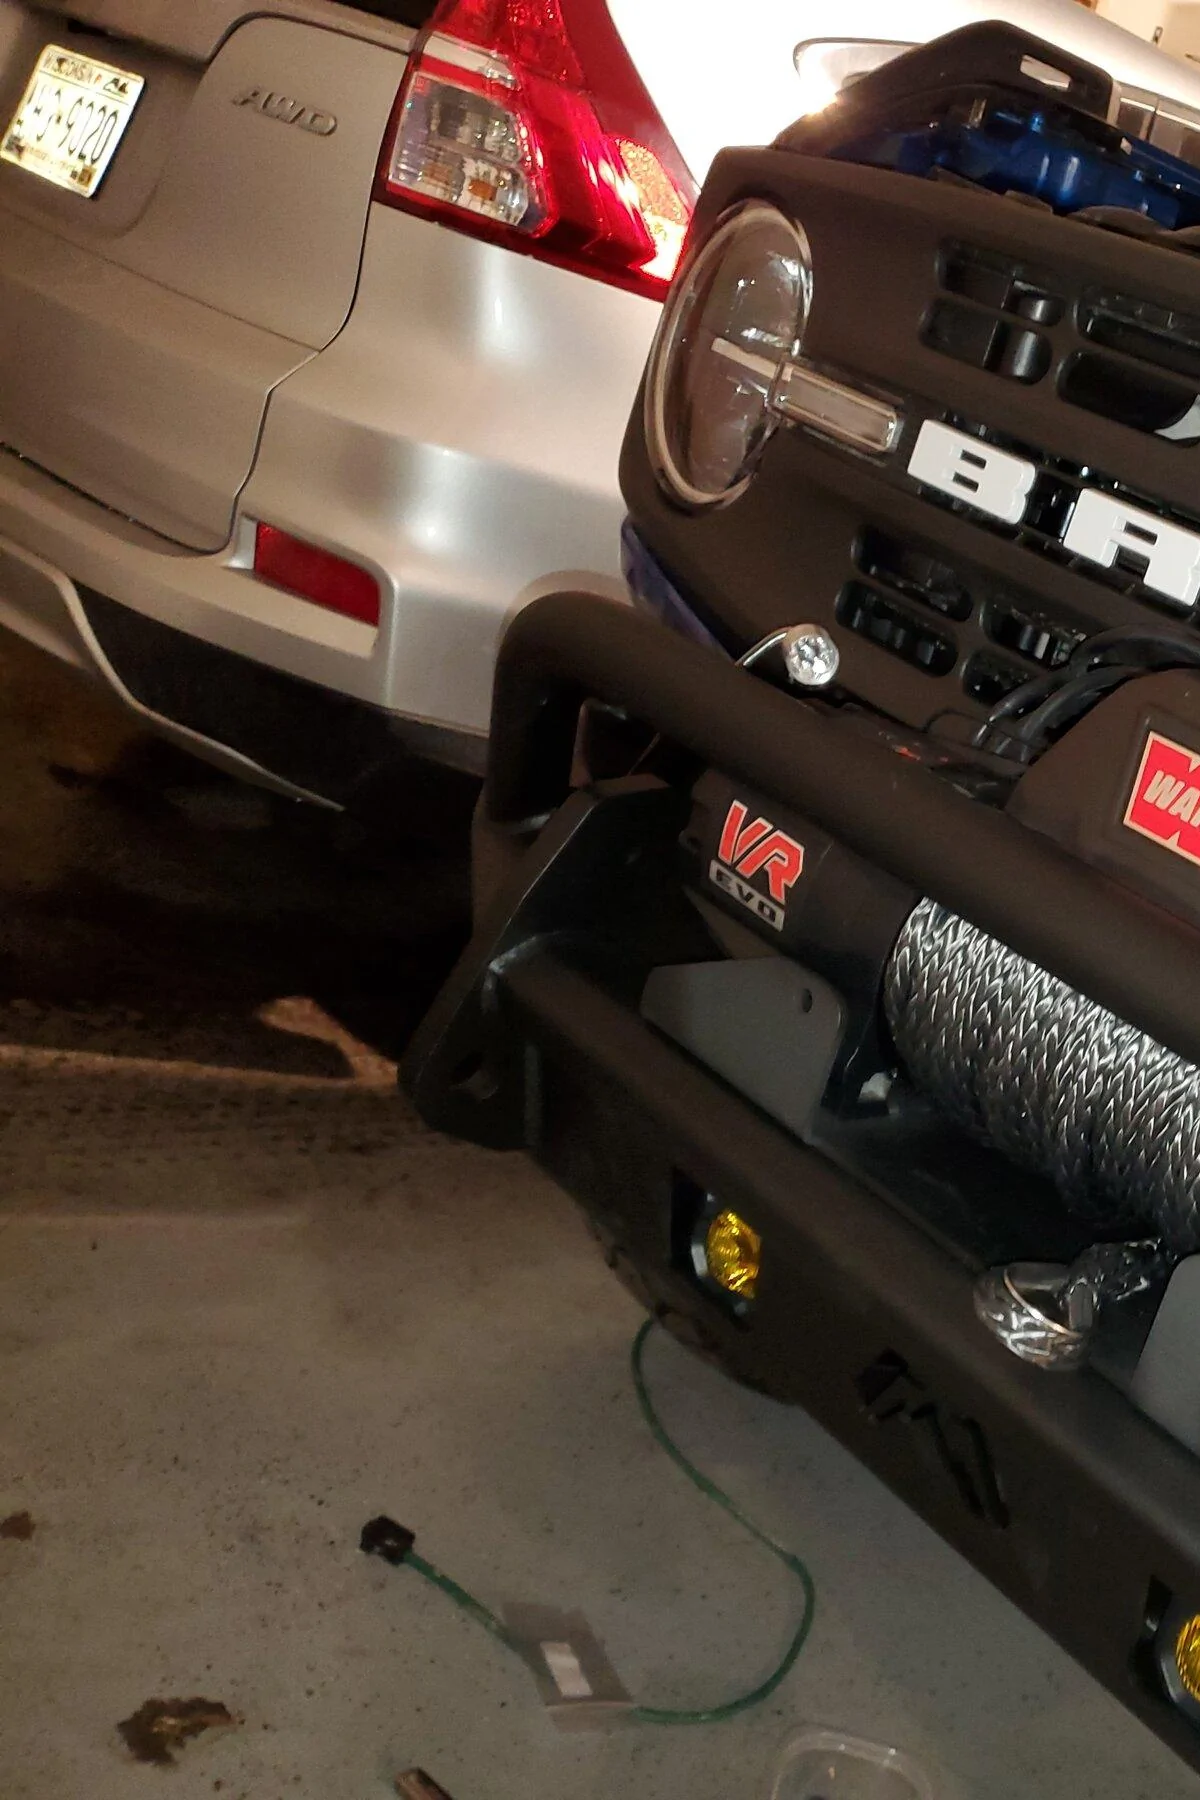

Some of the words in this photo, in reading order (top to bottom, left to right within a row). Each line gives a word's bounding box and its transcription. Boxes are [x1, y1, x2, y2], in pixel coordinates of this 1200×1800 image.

[231, 91, 338, 136] AWD
[717, 799, 805, 905] VR
[713, 866, 778, 924] EVO
